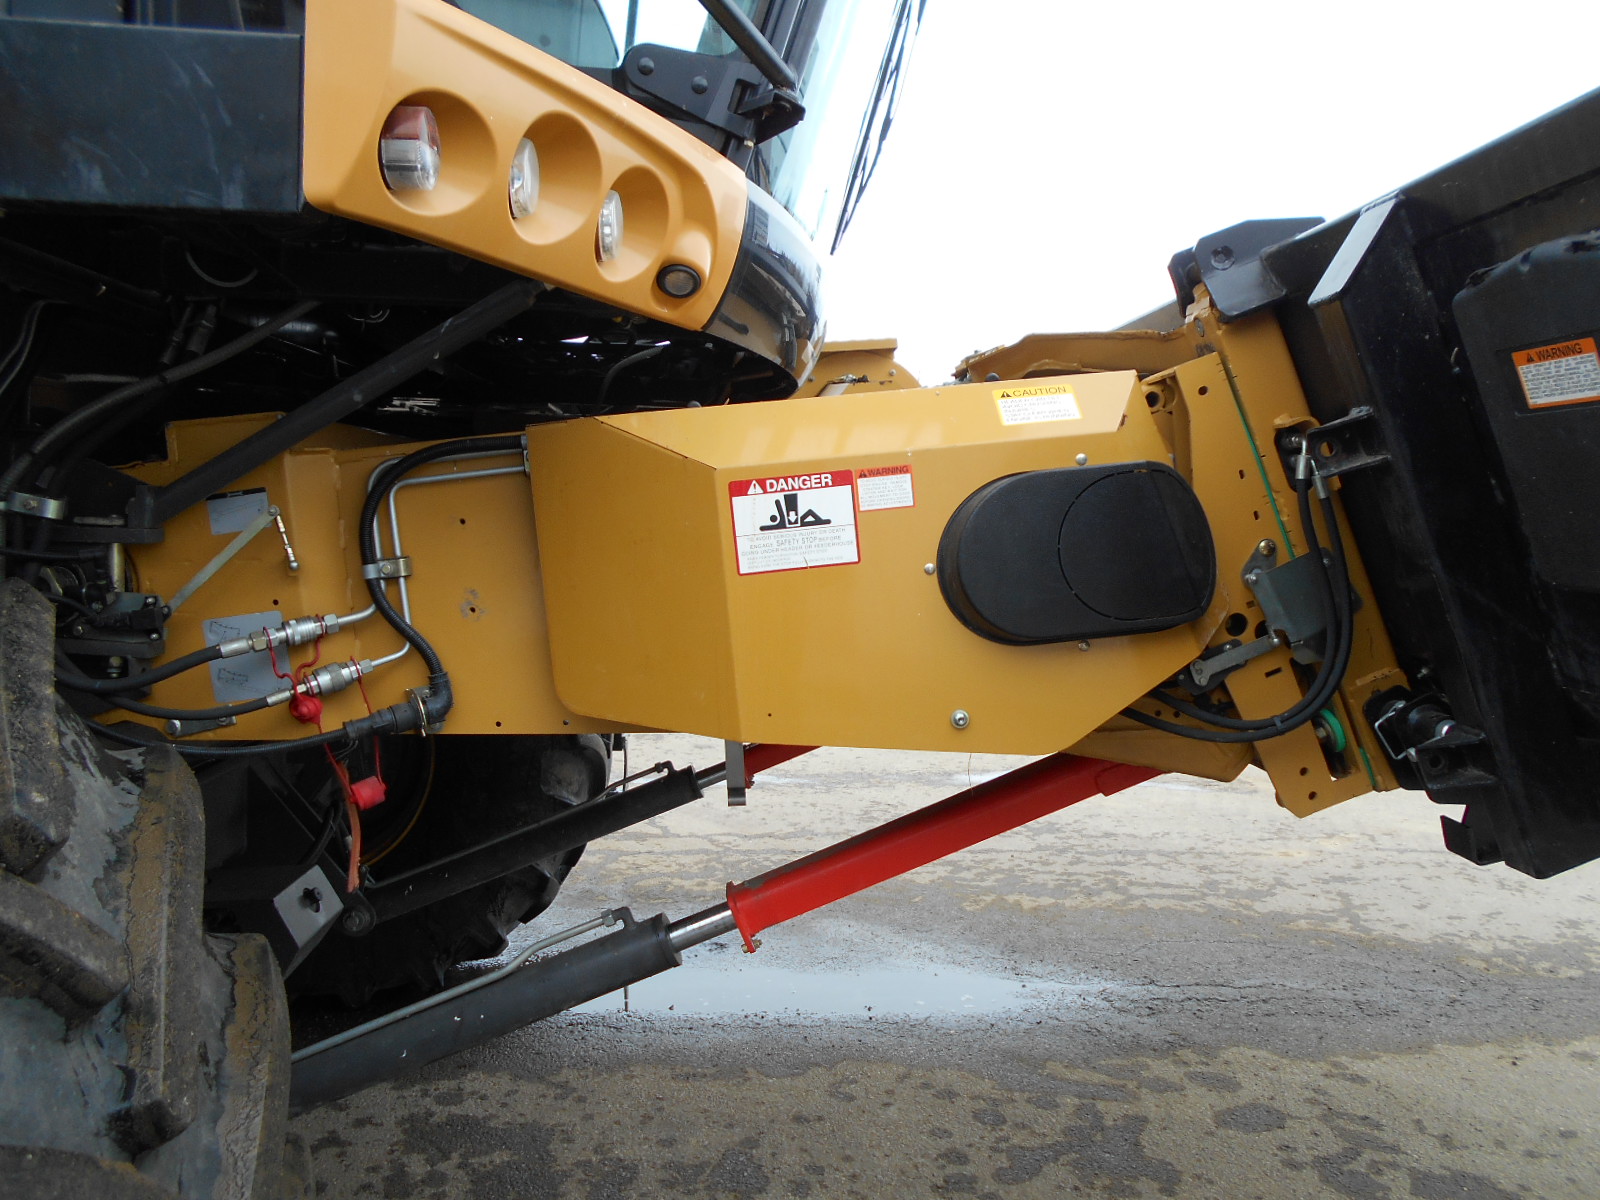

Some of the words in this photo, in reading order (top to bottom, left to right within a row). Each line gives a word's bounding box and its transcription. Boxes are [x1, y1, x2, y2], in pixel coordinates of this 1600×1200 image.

[1536, 343, 1583, 361] WARNING
[1013, 386, 1067, 397] CAUTION
[868, 466, 909, 476] WARNING
[766, 474, 833, 492] DANGER
[776, 539, 799, 547] SAFETY
